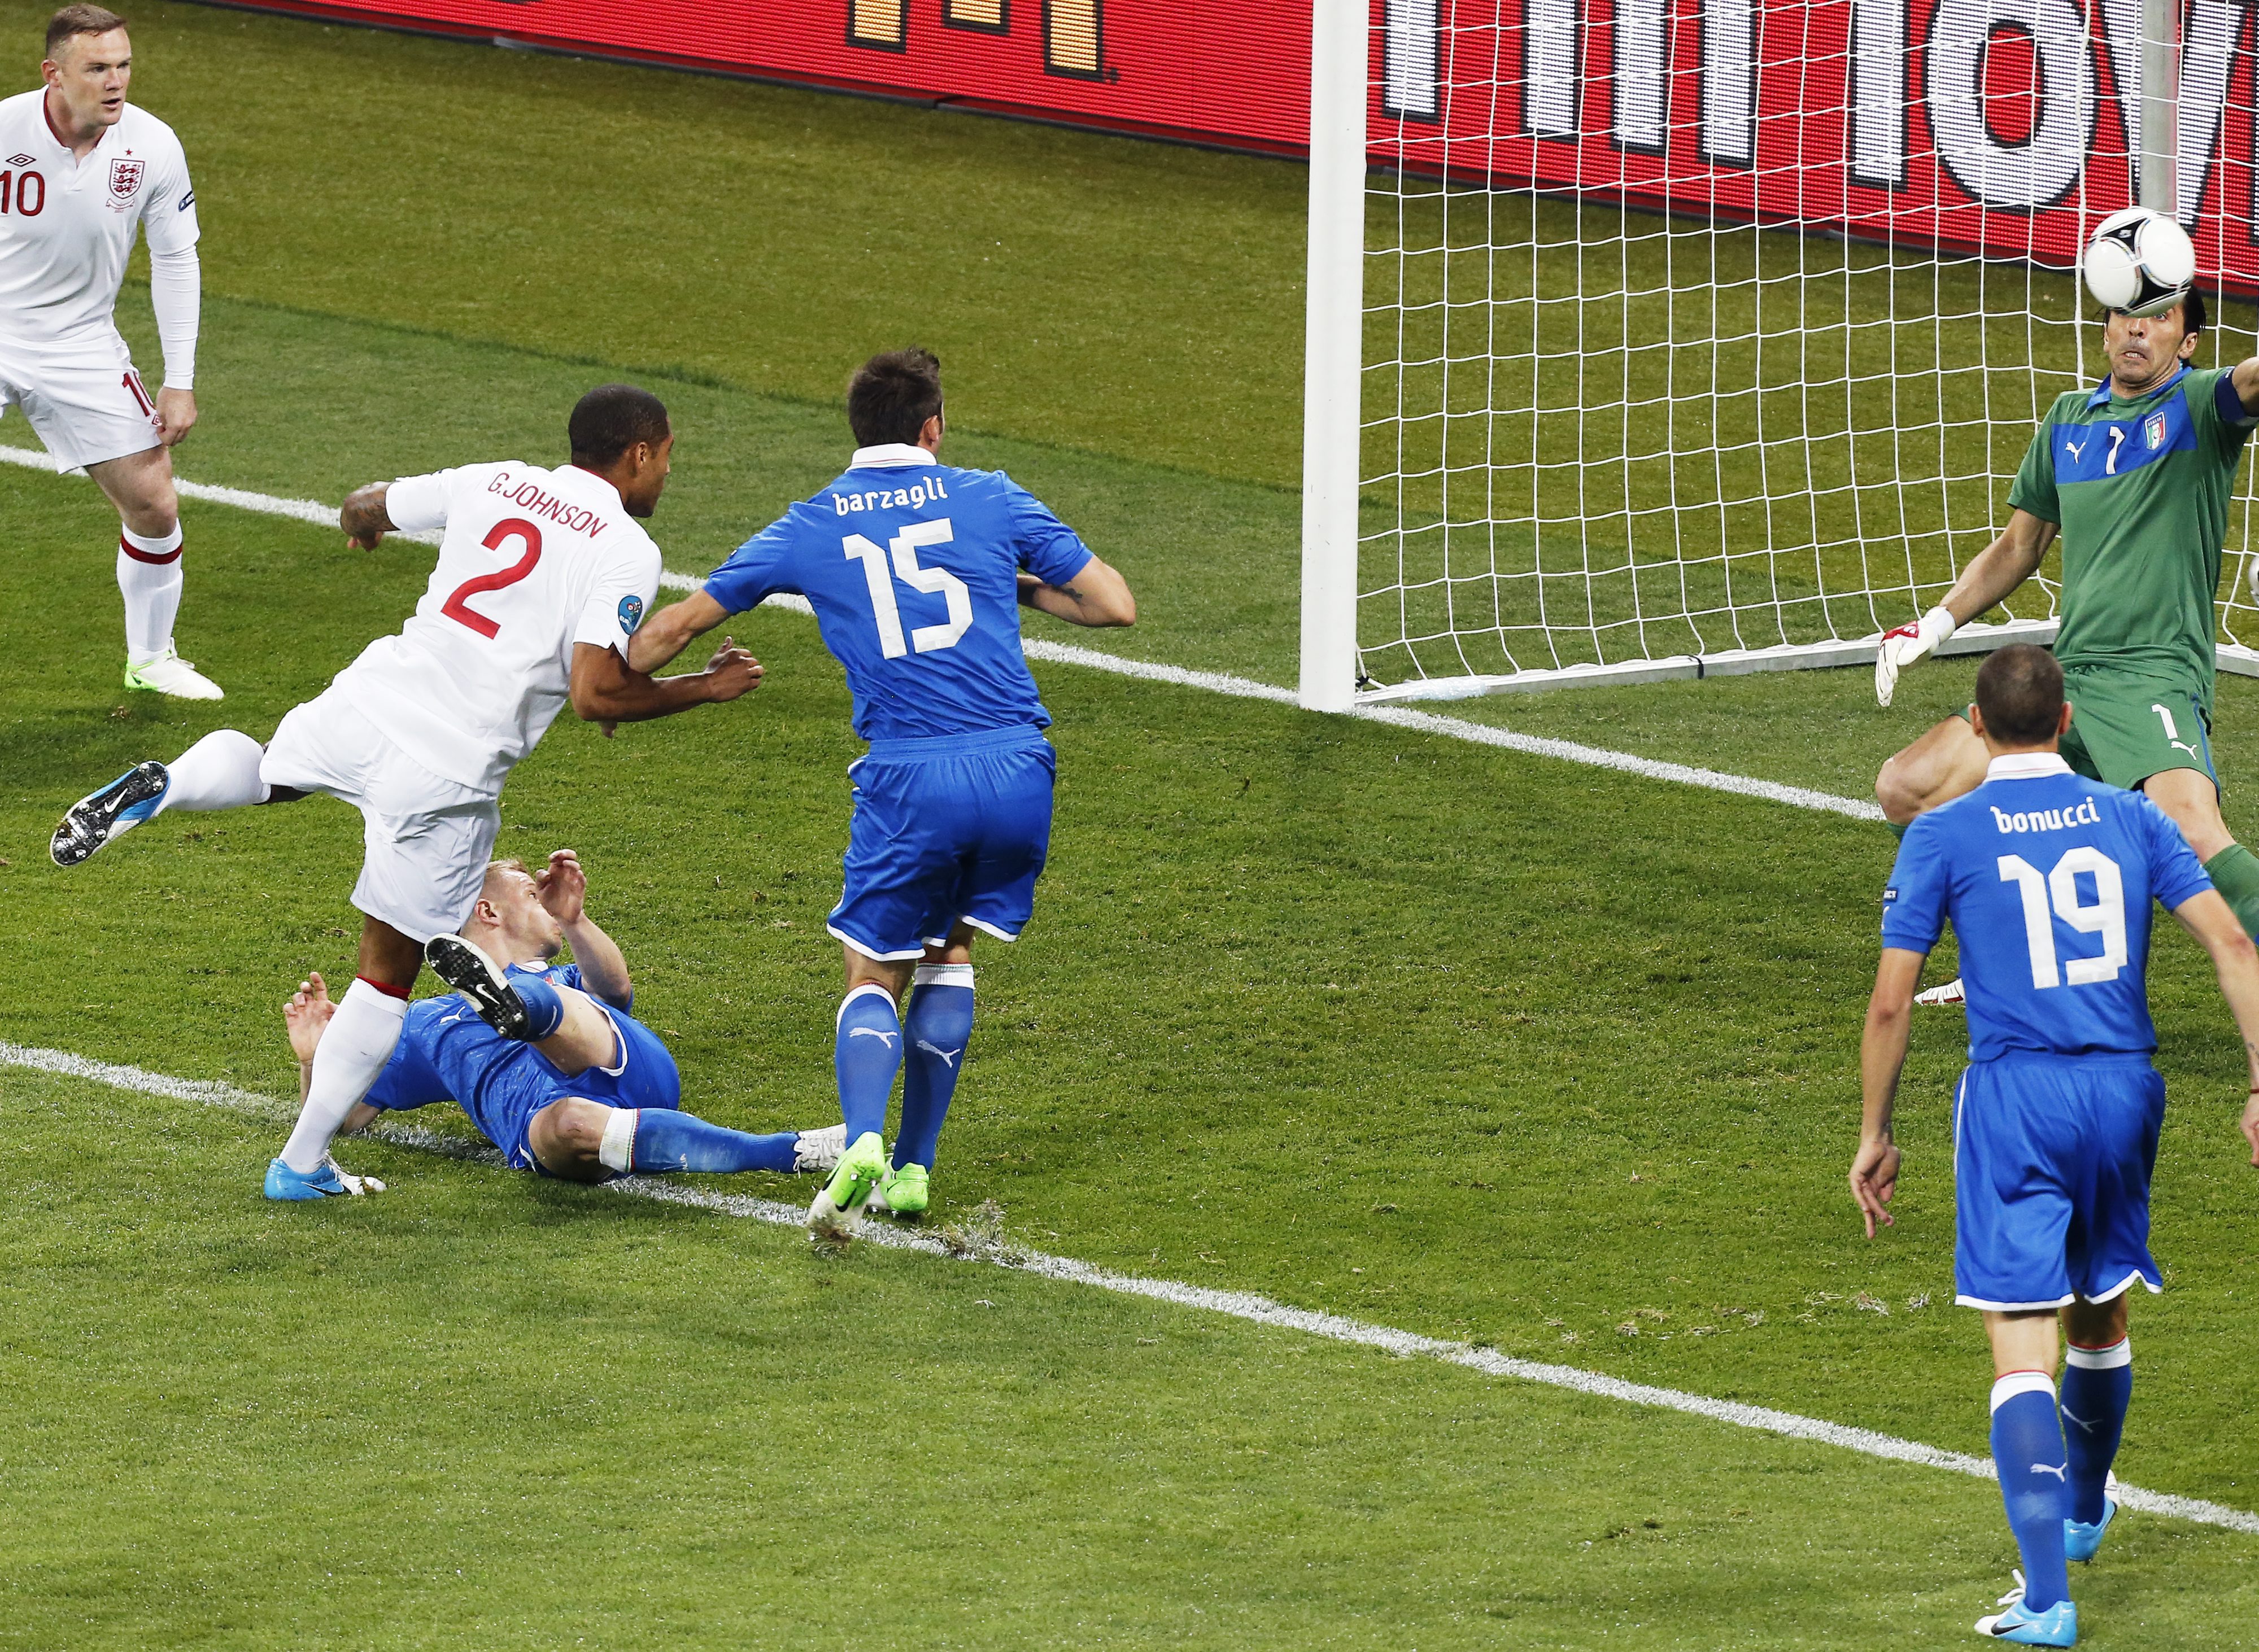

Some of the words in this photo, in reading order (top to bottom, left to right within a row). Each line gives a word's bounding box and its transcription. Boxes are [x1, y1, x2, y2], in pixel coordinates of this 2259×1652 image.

[0, 171, 45, 216] 10
[488, 473, 608, 538] G.JOHNSON
[832, 476, 948, 516] barzagli
[441, 518, 542, 640] 2
[841, 518, 974, 660] 15
[2151, 703, 2178, 740] 1
[1990, 796, 2101, 834] bonucci
[1997, 846, 2128, 990] 19
